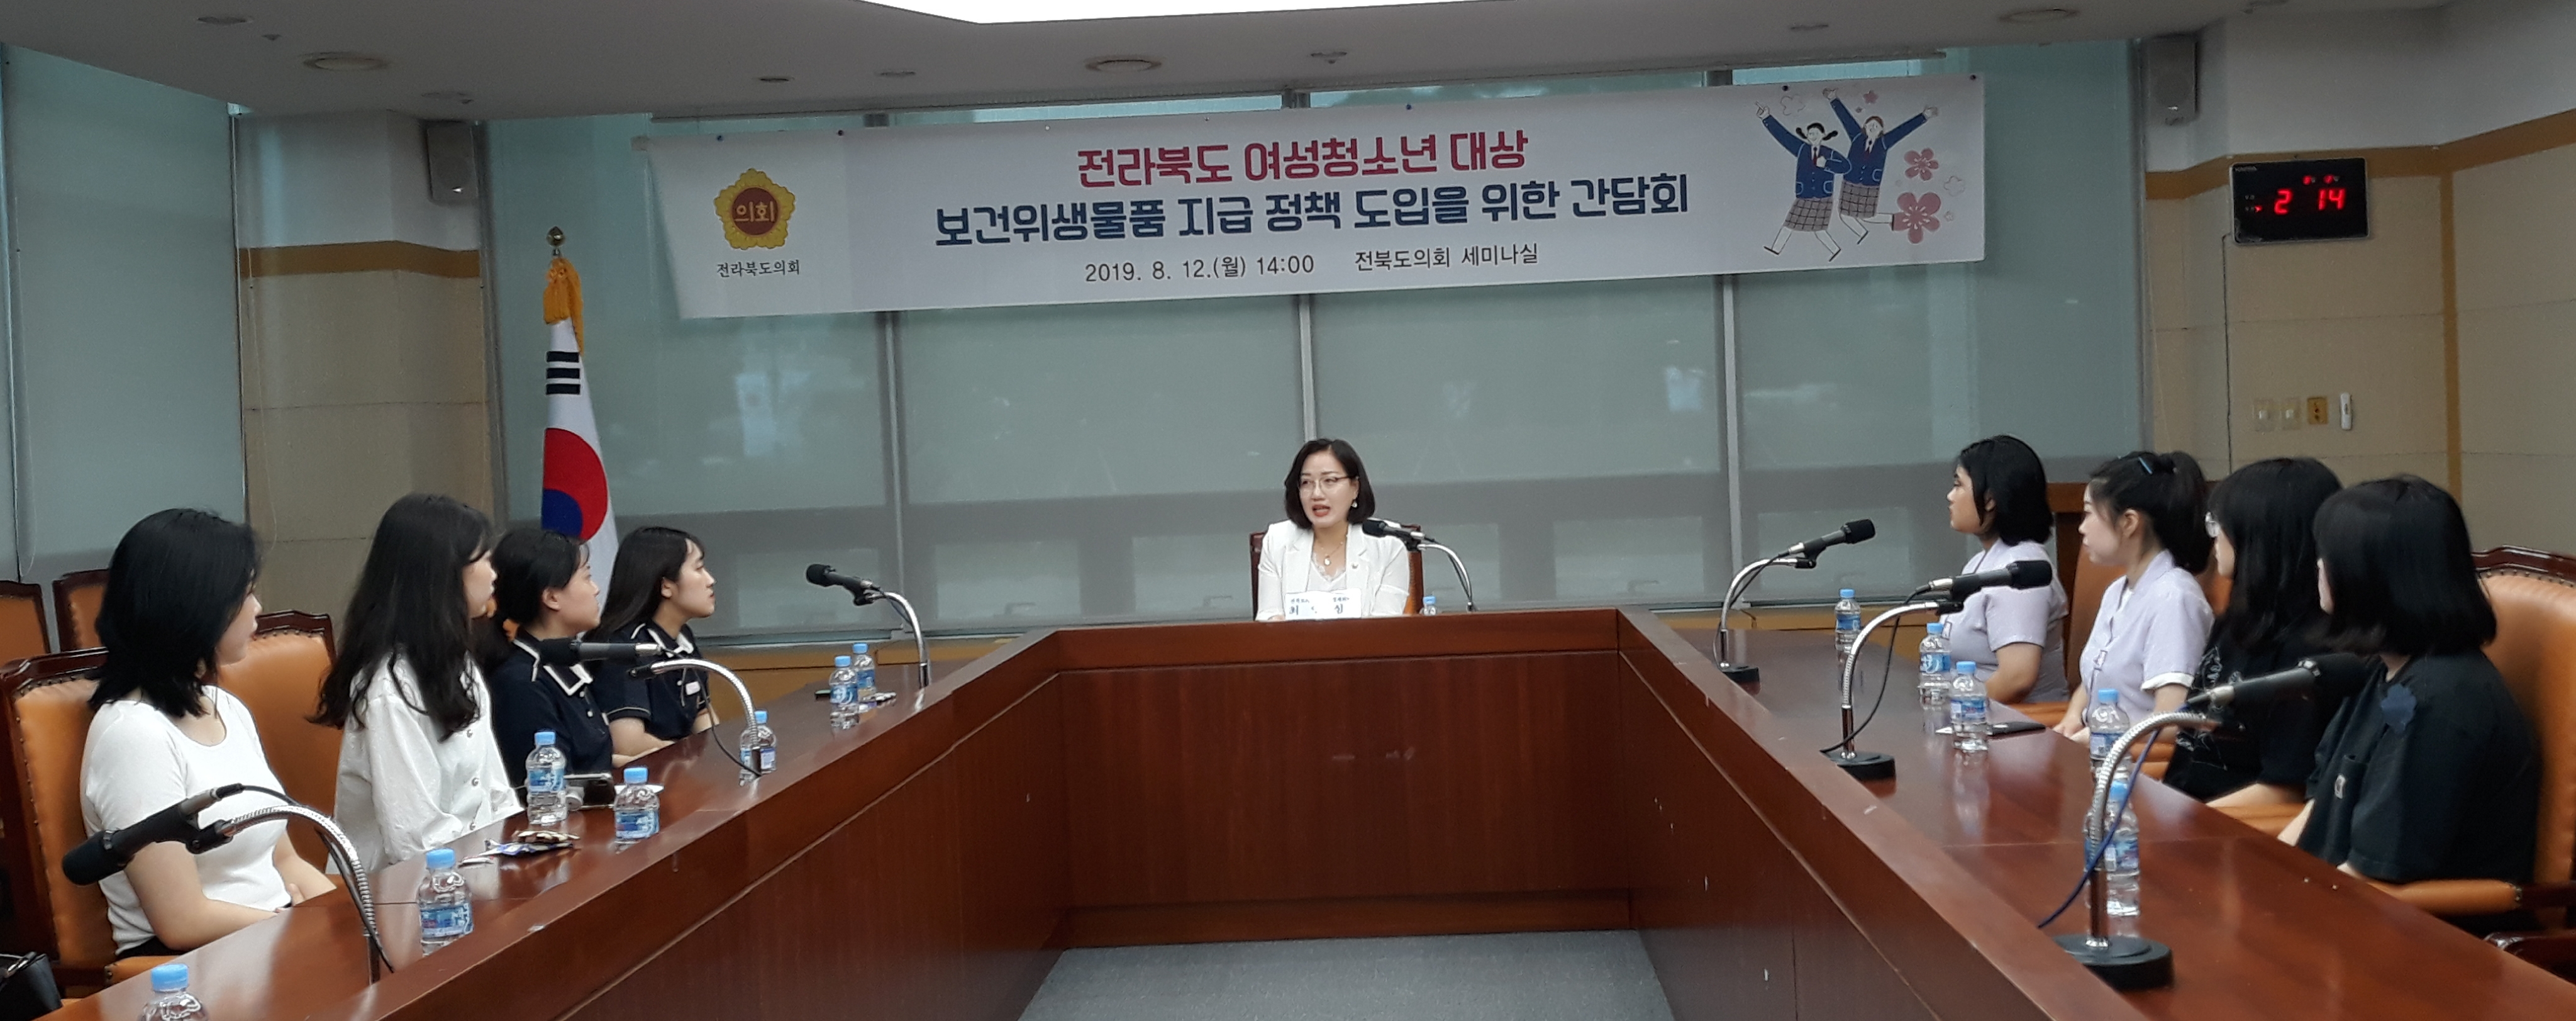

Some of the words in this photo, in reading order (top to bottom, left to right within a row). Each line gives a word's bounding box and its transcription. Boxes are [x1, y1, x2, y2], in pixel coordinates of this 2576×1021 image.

[1079, 145, 1232, 187] 전라북도
[1245, 135, 1437, 181] 여성청소년
[1450, 130, 1528, 170] 대상
[733, 200, 775, 223] 의회
[935, 199, 1166, 247] 보건위생물품
[1177, 196, 1254, 237] 지급
[1265, 191, 1341, 232] 정책
[1354, 186, 1470, 229] 도입을
[1481, 180, 1561, 222] 위한
[1570, 172, 1688, 218] 간담회
[2273, 189, 2292, 215] 2
[2318, 189, 2345, 210] 14
[716, 259, 799, 278] 전라북도의회
[1085, 262, 1141, 282] 2019.
[1152, 260, 1171, 280] 8.
[1182, 255, 1246, 279] 12.(월)
[1257, 254, 1314, 276] 14:00
[1355, 247, 1450, 272] 전북도의회
[1461, 242, 1538, 267] 세미나실
